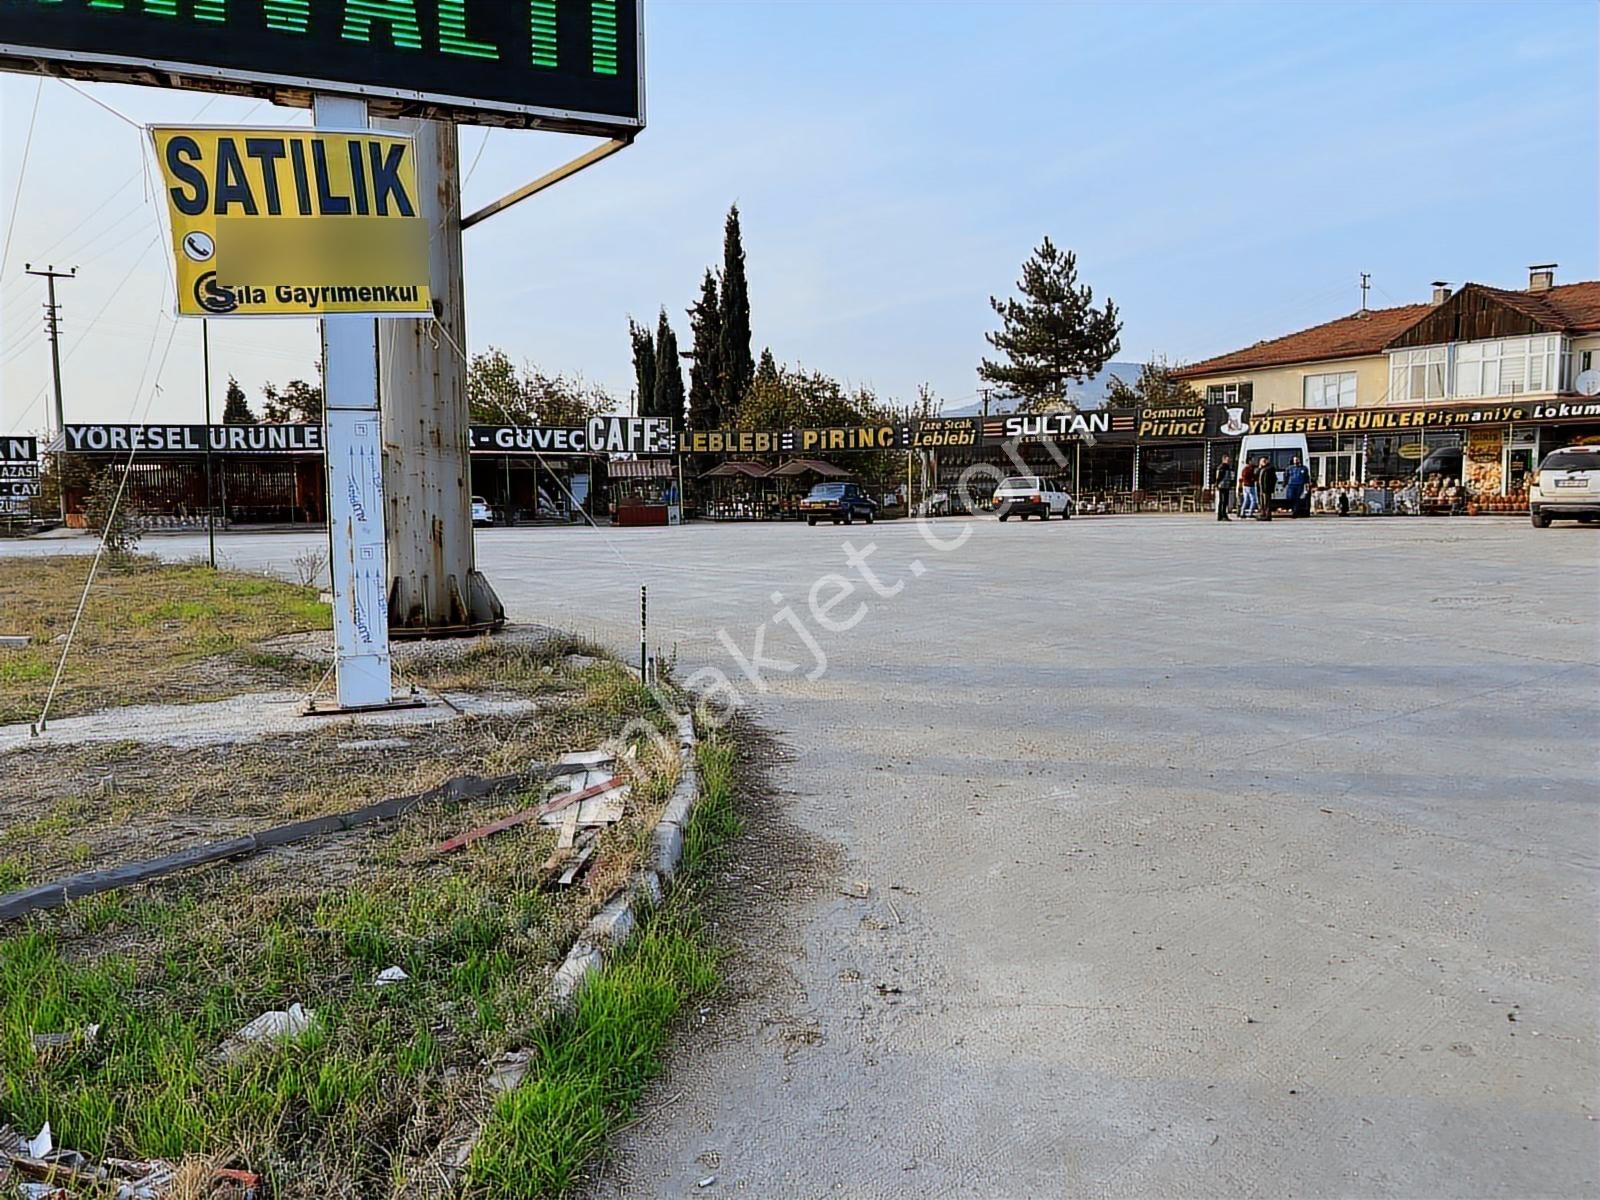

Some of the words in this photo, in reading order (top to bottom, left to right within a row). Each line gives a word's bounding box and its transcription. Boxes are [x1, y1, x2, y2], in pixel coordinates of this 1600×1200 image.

[165, 136, 415, 217] SATILIK
[1006, 413, 1109, 436] SULTAN
[1139, 418, 1206, 436] Pirinci
[1332, 411, 1425, 431] ÜRÜNLER
[1533, 403, 1600, 418] Lokum
[66, 426, 199, 449] YÖRESEL
[209, 427, 326, 449] ÜRÜNLE
[588, 417, 659, 452] CAFE
[913, 429, 976, 446] Leblebi
[0, 466, 36, 477] AZASI
